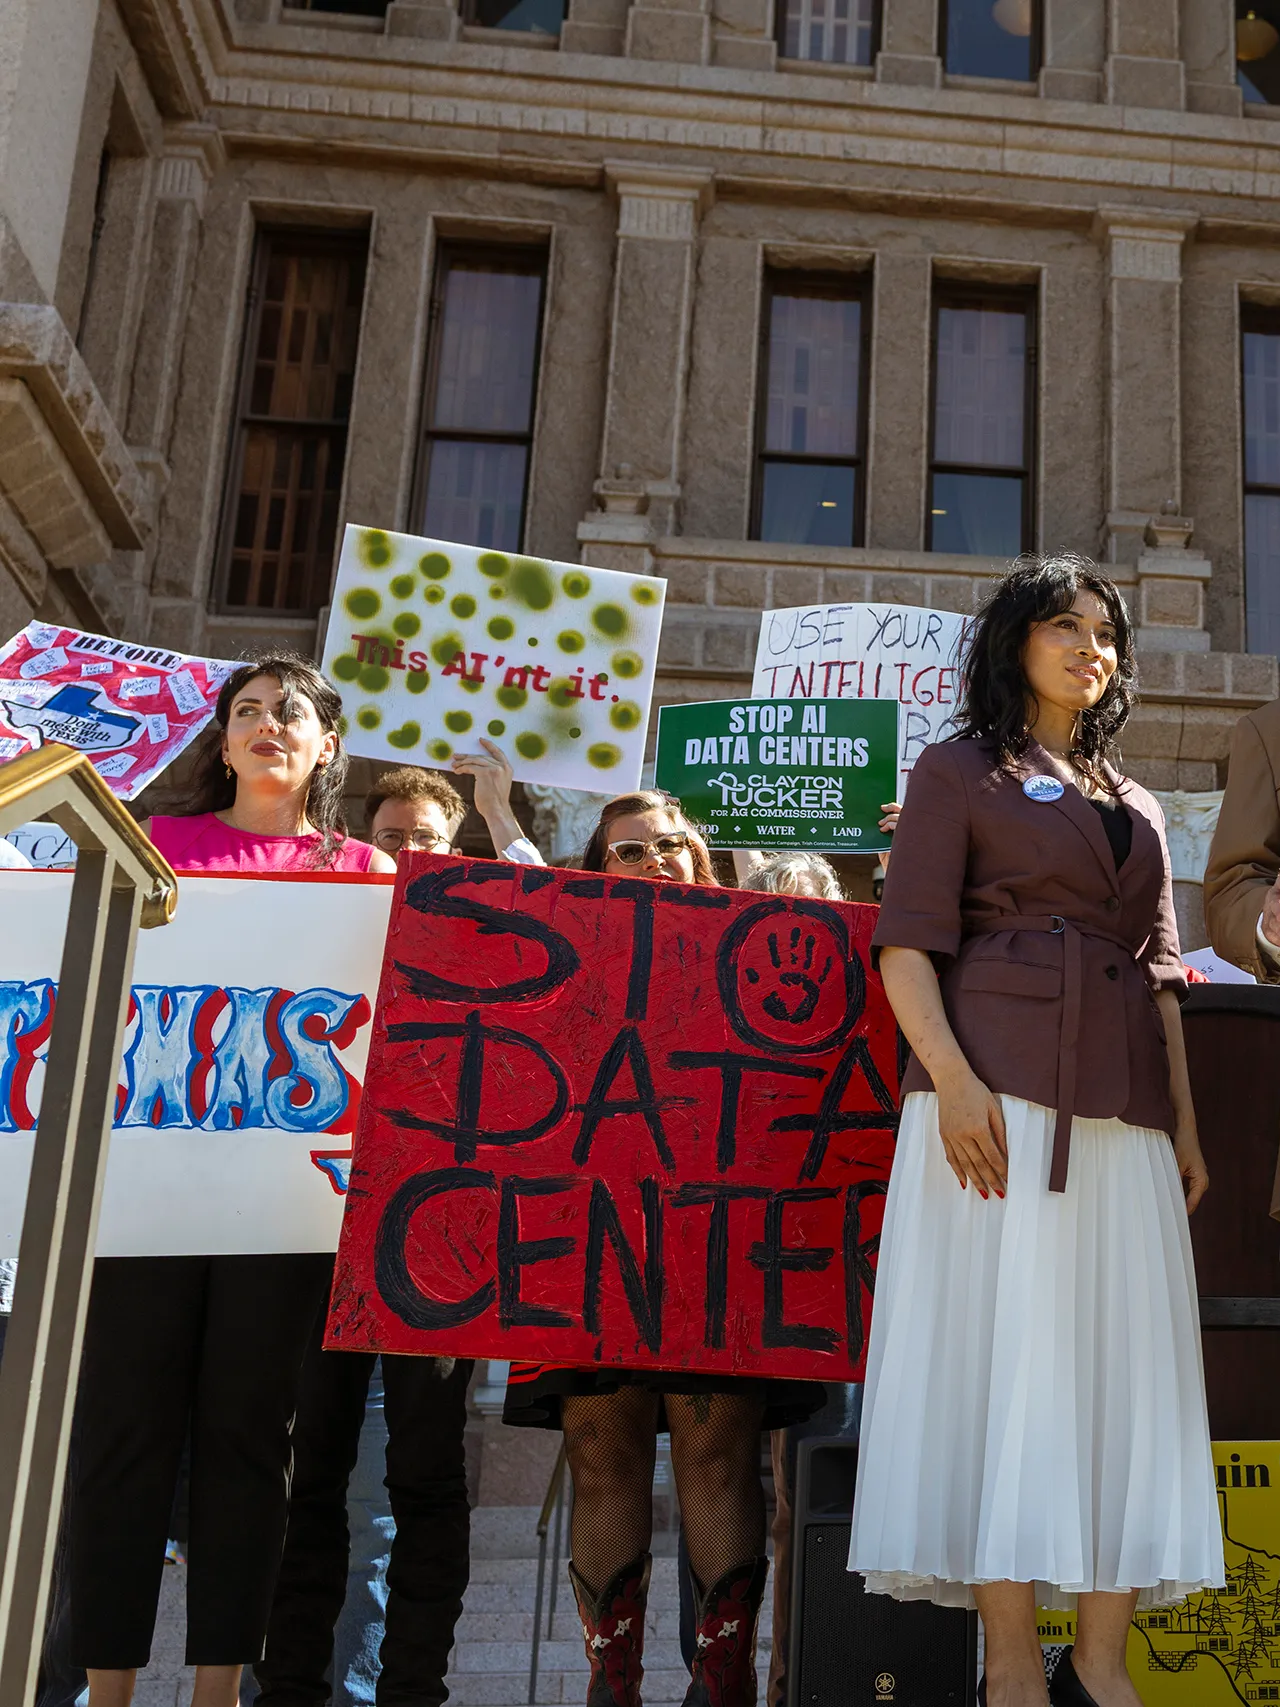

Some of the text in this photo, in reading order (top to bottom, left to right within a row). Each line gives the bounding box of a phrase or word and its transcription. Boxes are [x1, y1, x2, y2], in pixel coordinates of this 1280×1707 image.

[768, 606, 853, 656] USE
[866, 607, 943, 653] YOUR
[73, 635, 183, 671] BEFORE
[351, 633, 429, 674] This
[564, 666, 620, 703] it.
[40, 718, 112, 742] mess with
[729, 704, 827, 735] STOP AI
[684, 736, 750, 766] DATA
[758, 735, 870, 768] CENTERS
[708, 777, 844, 809] TUCKER
[747, 774, 843, 790] CLAYTON
[710, 807, 845, 820] FOR AG COMMISSIONER
[696, 823, 863, 837] OOD WATER LAND
[393, 863, 905, 1064] STO
[380, 1010, 901, 1183] DATA
